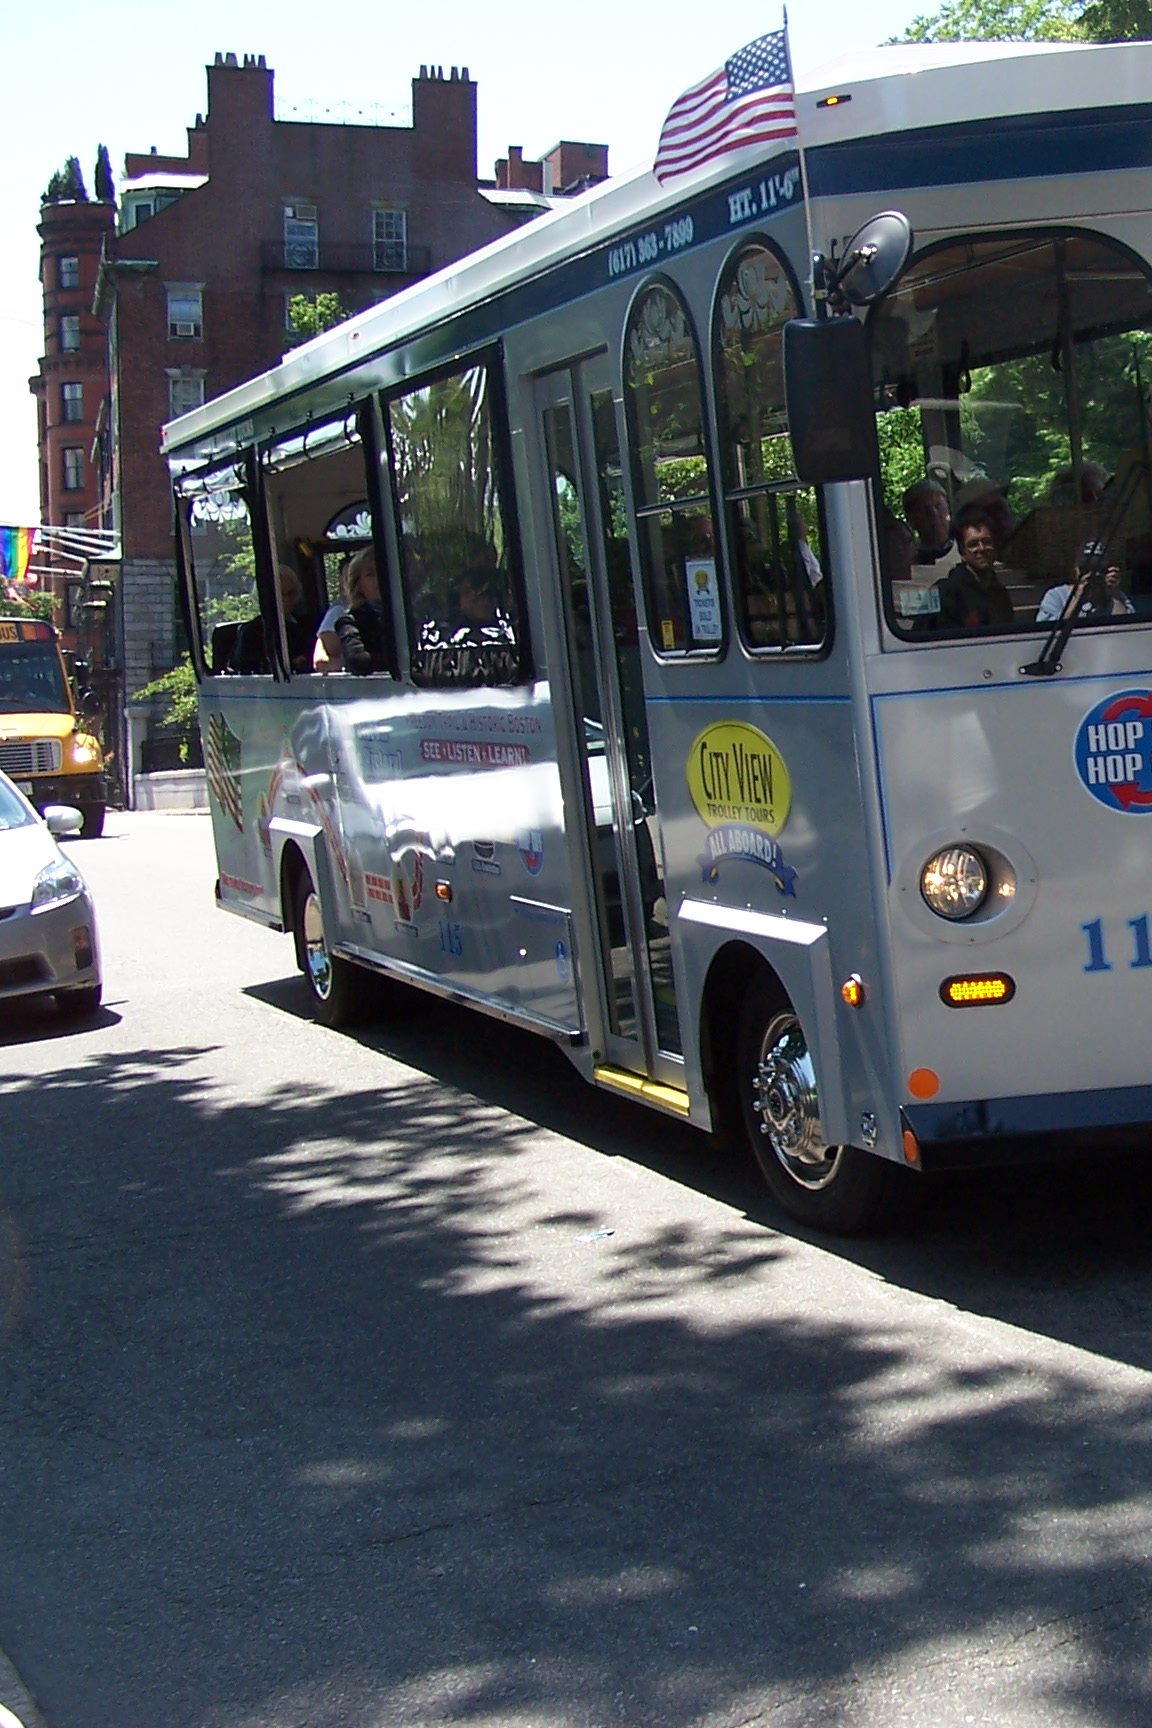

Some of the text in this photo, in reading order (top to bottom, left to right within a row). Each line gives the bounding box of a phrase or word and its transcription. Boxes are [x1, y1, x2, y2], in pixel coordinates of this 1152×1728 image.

[728, 187, 757, 224] HT.
[608, 244, 637, 276] (617)
[0, 625, 17, 640] US
[1087, 721, 1144, 752] HOP
[423, 742, 441, 759] SEE
[447, 743, 481, 763] LISTEN
[701, 741, 774, 805] CITY VIEW
[1087, 753, 1143, 784] HOP
[707, 803, 775, 823] TROLLEY TOURS
[709, 829, 777, 868] ALL ABOARD!
[438, 919, 463, 957] 115
